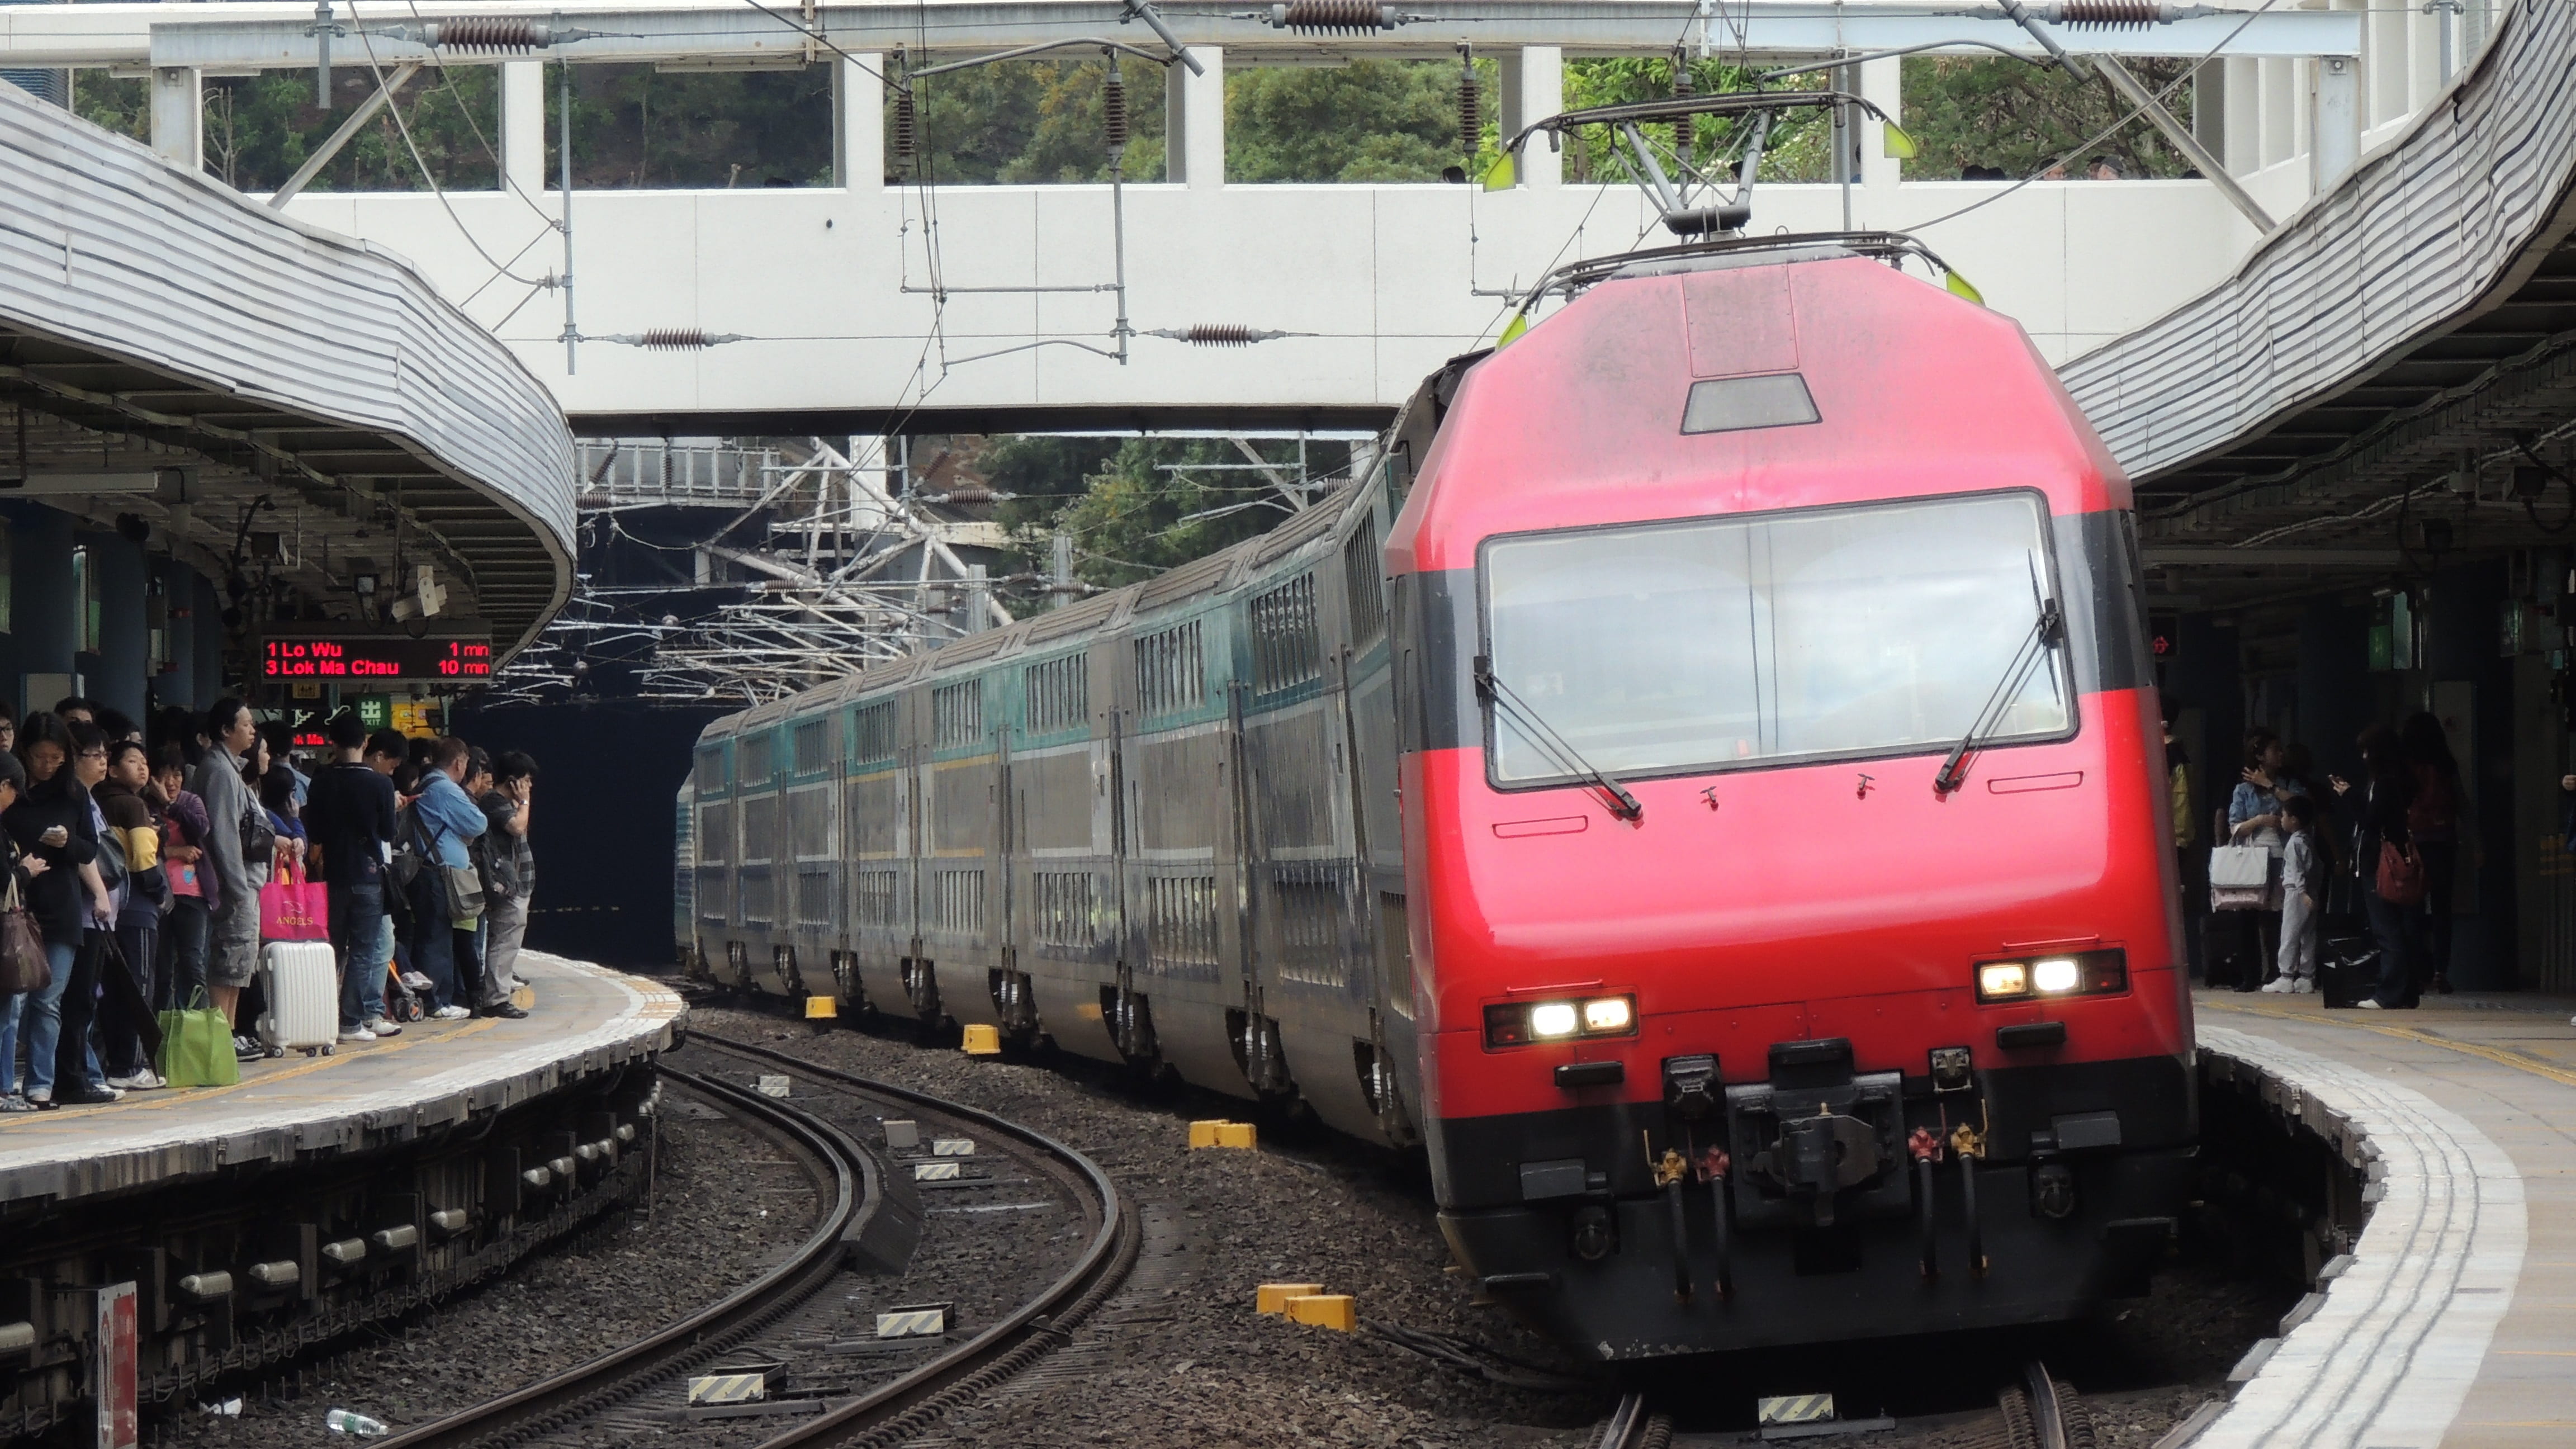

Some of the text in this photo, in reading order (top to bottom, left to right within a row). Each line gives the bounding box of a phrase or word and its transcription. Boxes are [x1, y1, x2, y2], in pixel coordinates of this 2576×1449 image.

[267, 642, 489, 657] 1 Lo Wu 1 min
[266, 660, 489, 675] 3 Lok Ma Chau 10 min
[276, 916, 313, 926] ANGELS
